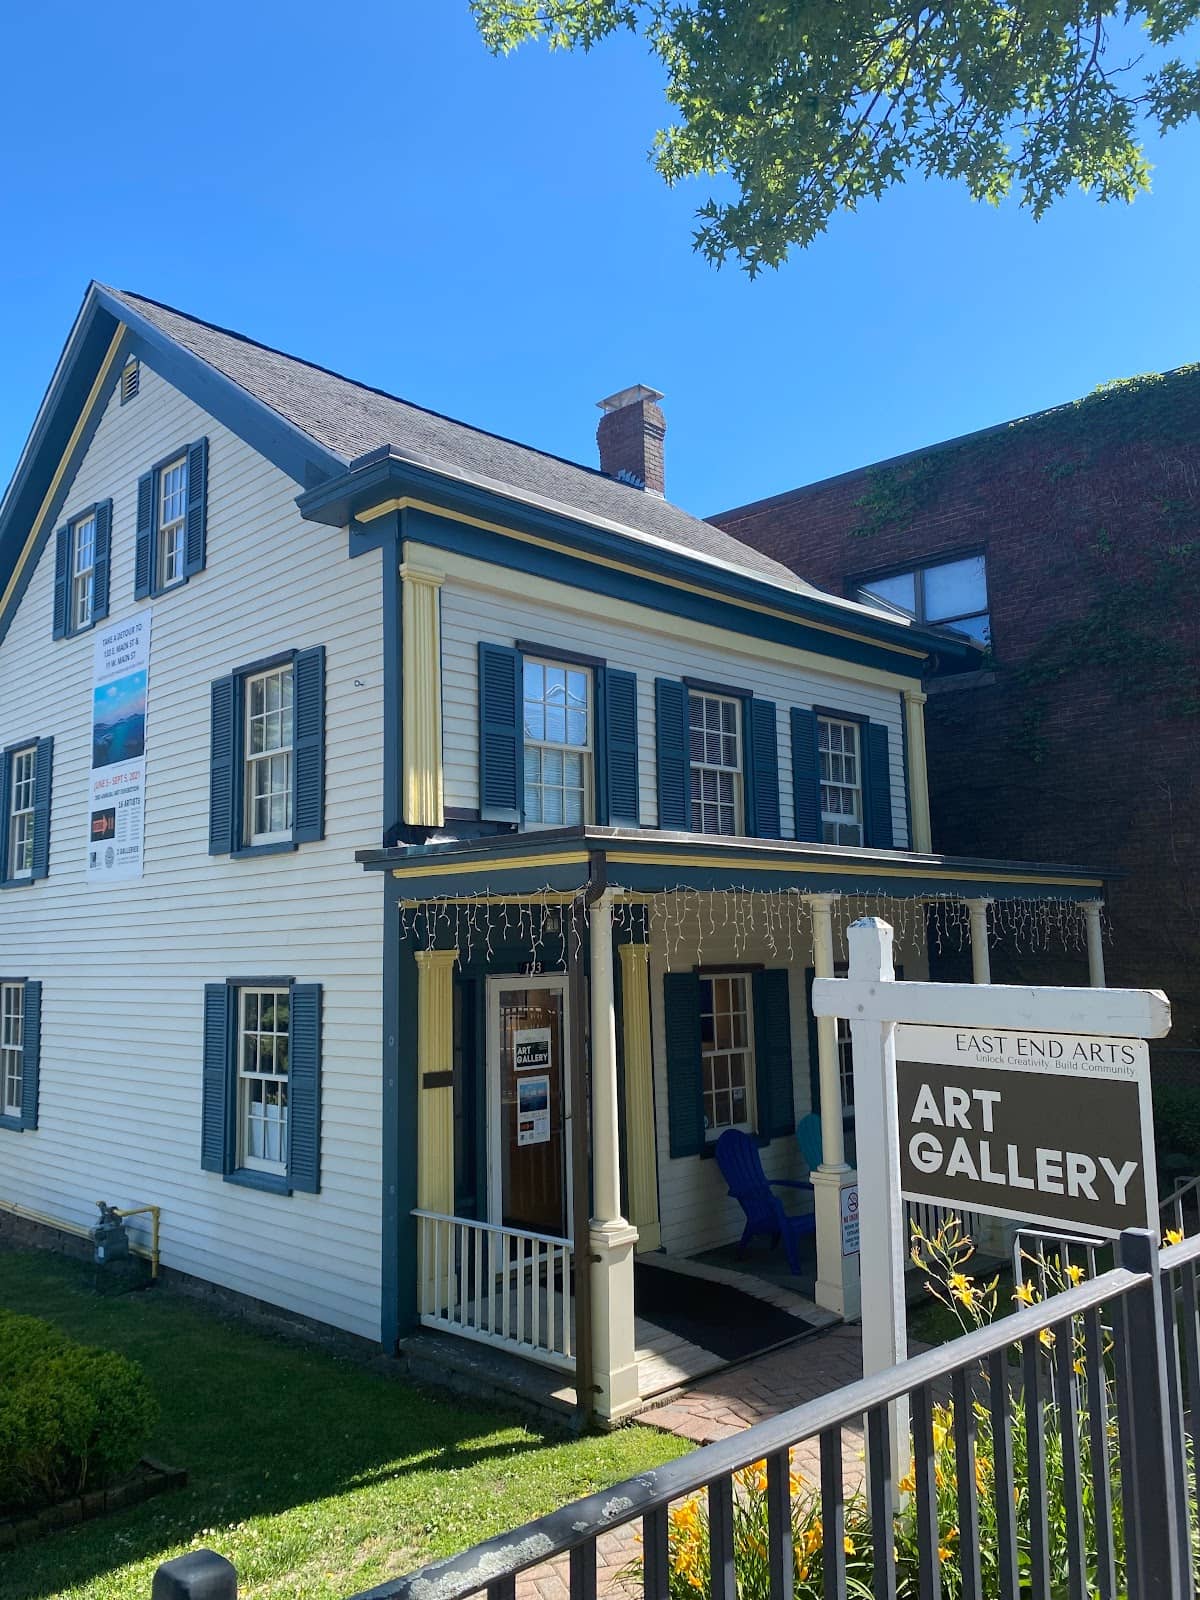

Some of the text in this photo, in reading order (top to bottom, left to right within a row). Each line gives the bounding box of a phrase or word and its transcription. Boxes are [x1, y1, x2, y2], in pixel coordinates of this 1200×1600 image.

[103, 635, 113, 647] TAKE
[117, 626, 135, 641] DETOUR
[516, 1053, 548, 1064] GALLERY
[517, 1046, 531, 1055] ART
[956, 1033, 1136, 1065] EAST END ARTS
[975, 1053, 1136, 1077] Unlock Creativity Build Community
[911, 1083, 1002, 1133] ART
[908, 1131, 1138, 1206] GALLERY
